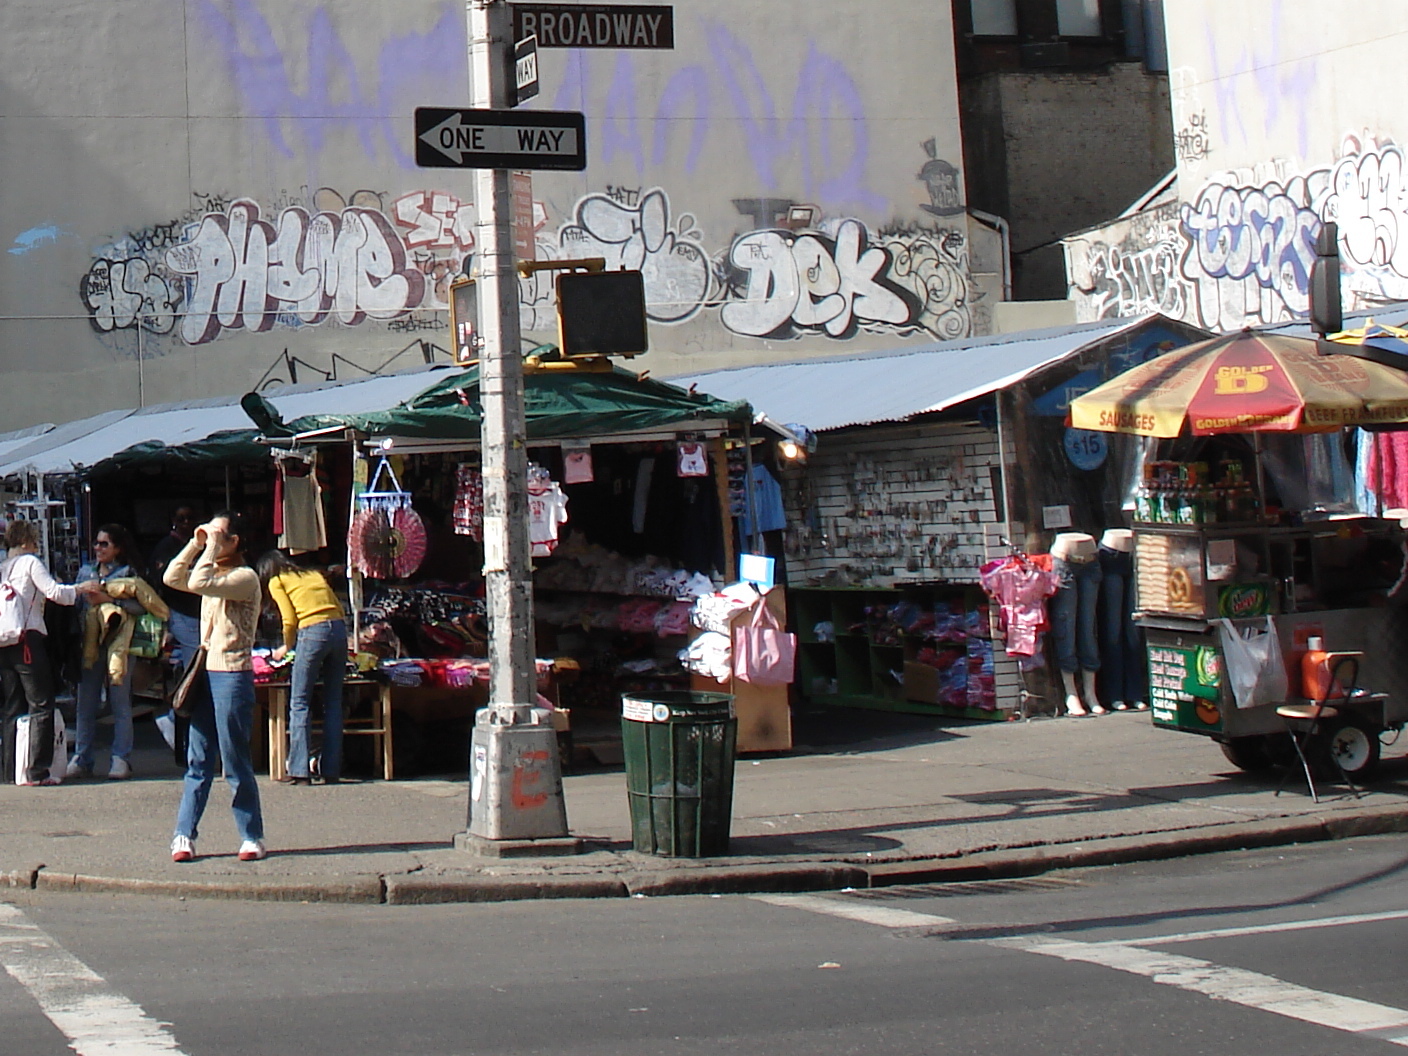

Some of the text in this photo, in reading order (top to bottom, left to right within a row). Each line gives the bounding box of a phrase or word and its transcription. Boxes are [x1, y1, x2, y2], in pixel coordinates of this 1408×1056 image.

[521, 12, 663, 46] BROADWAY
[516, 57, 534, 84] WAY
[439, 127, 565, 152] ONE WAY
[1099, 410, 1156, 431] SAUSAGES
[1195, 417, 1237, 430] GOLDEN
[1309, 408, 1336, 422] BEEF
